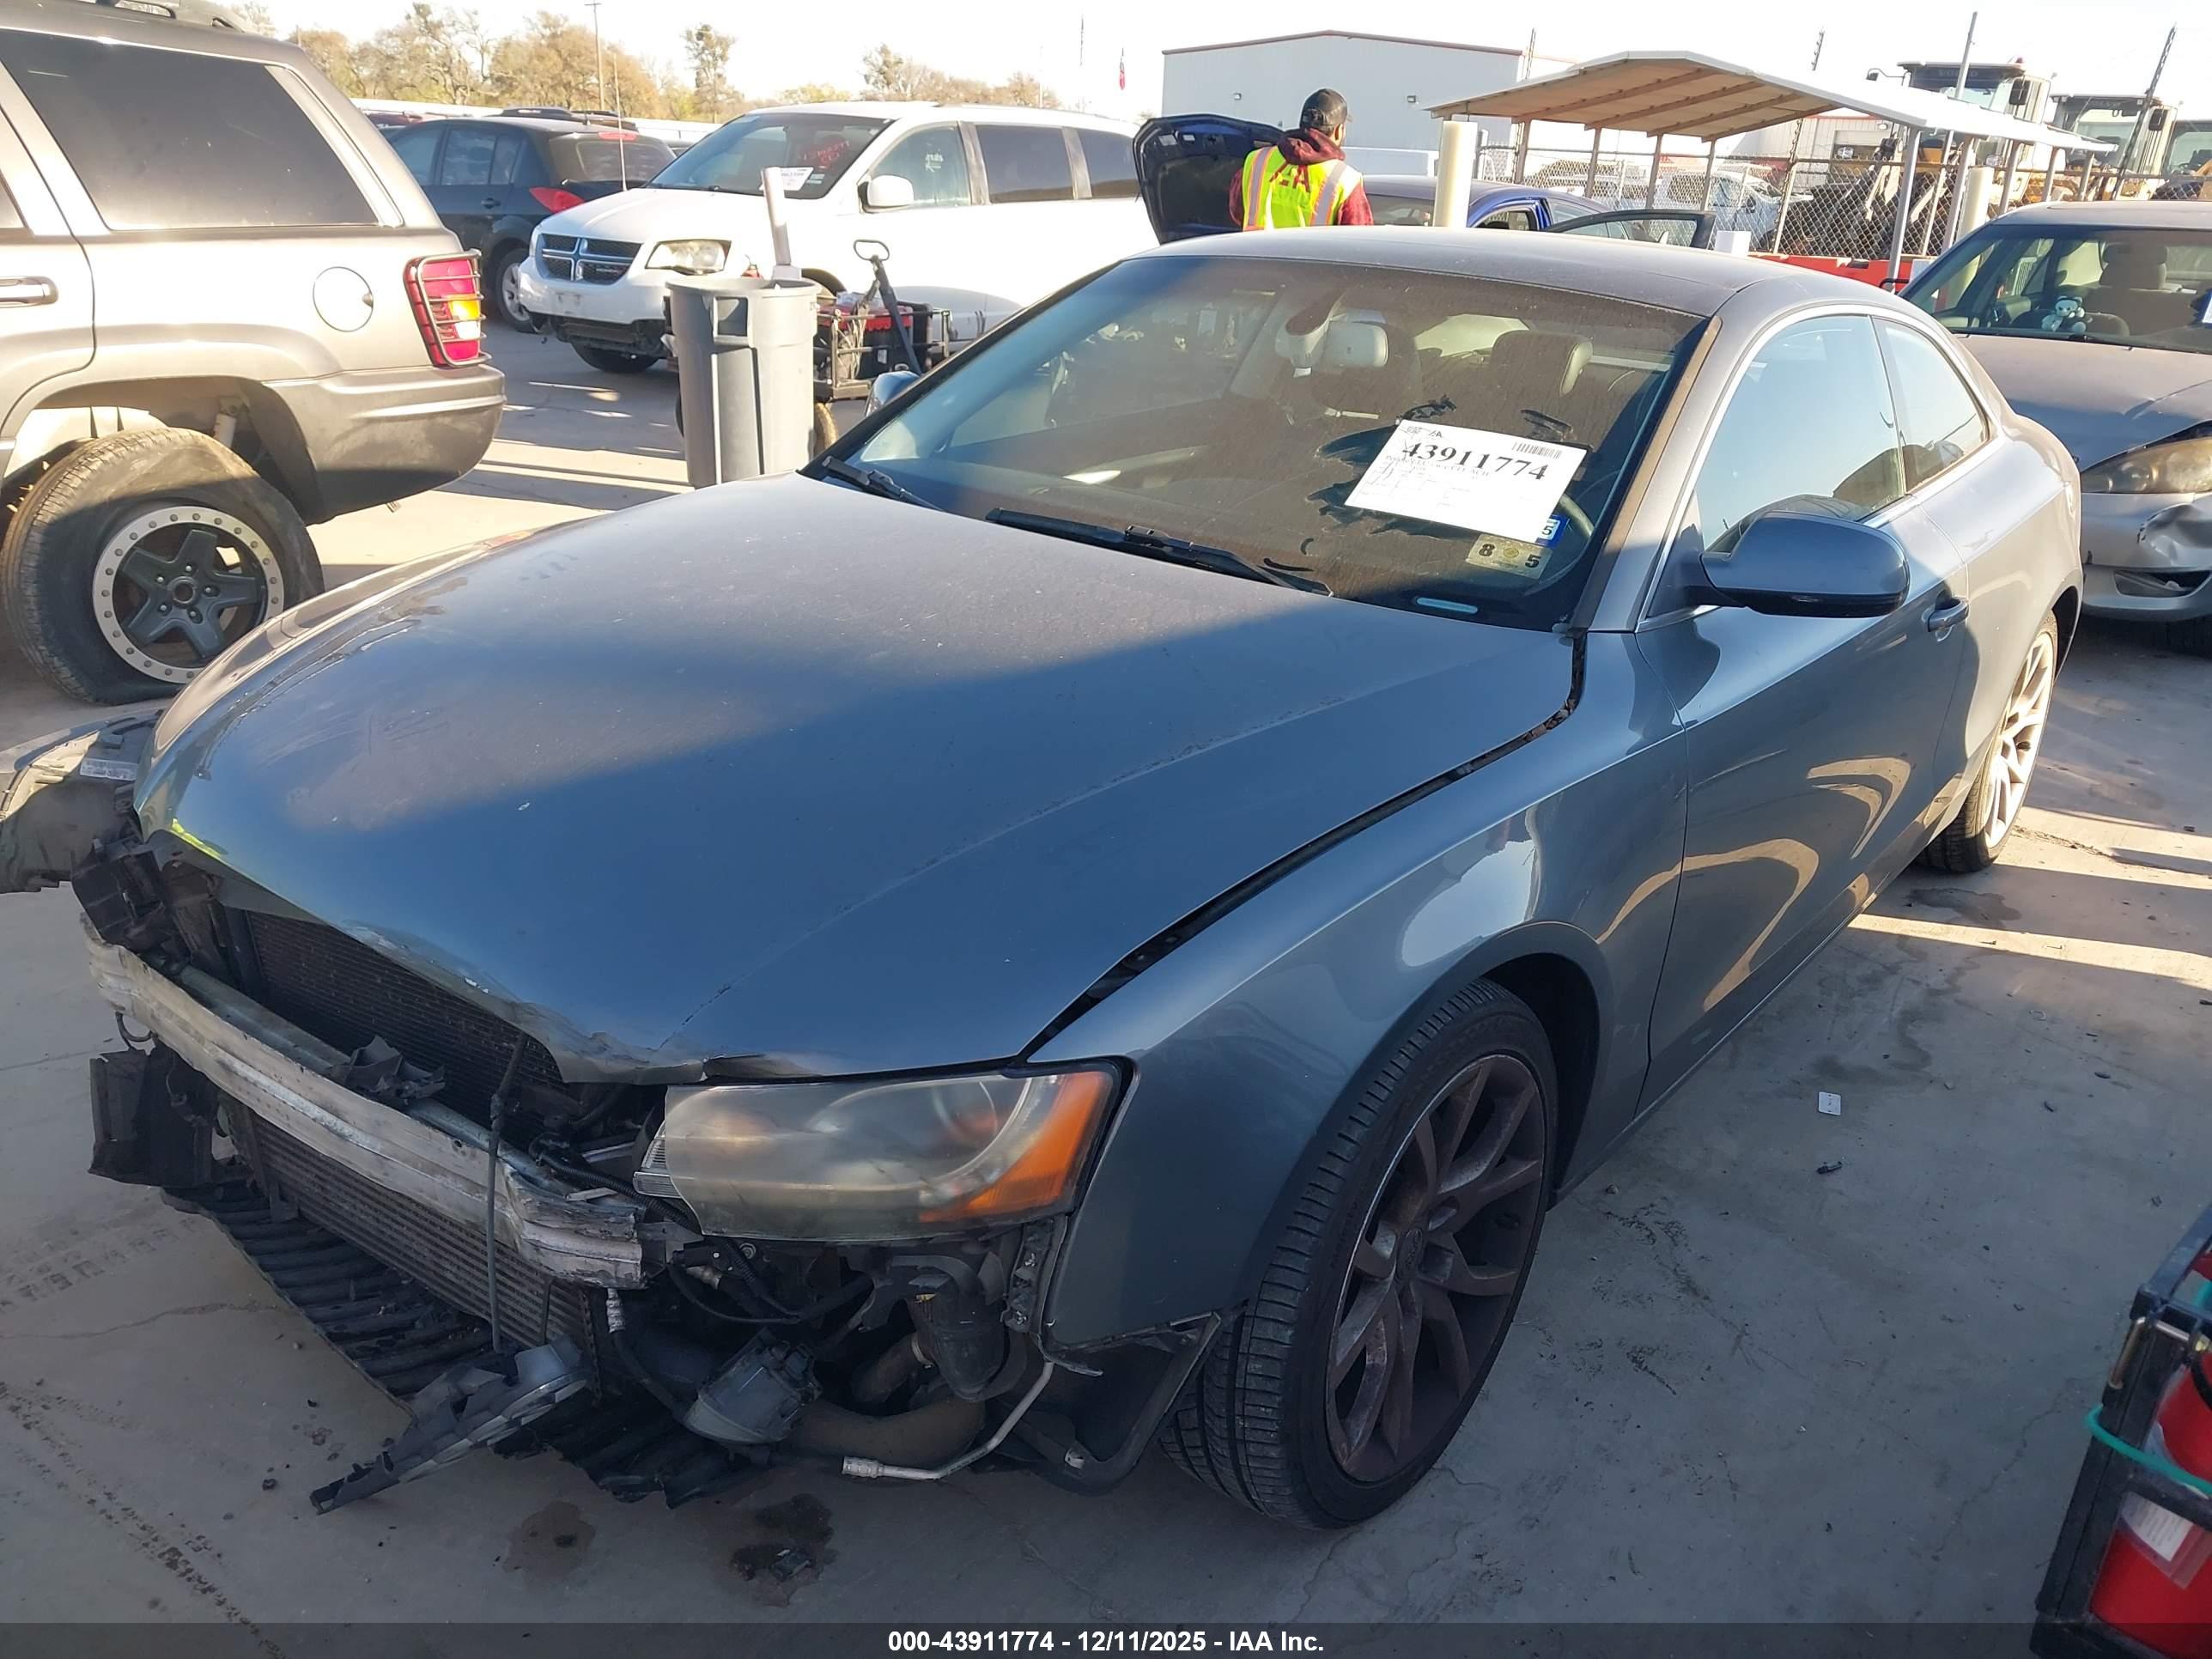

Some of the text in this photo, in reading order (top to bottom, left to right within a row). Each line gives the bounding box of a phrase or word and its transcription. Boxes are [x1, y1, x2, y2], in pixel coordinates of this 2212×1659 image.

[1402, 442, 1549, 481] 43911774
[1479, 543, 1496, 557] 8
[1525, 554, 1542, 568] 5
